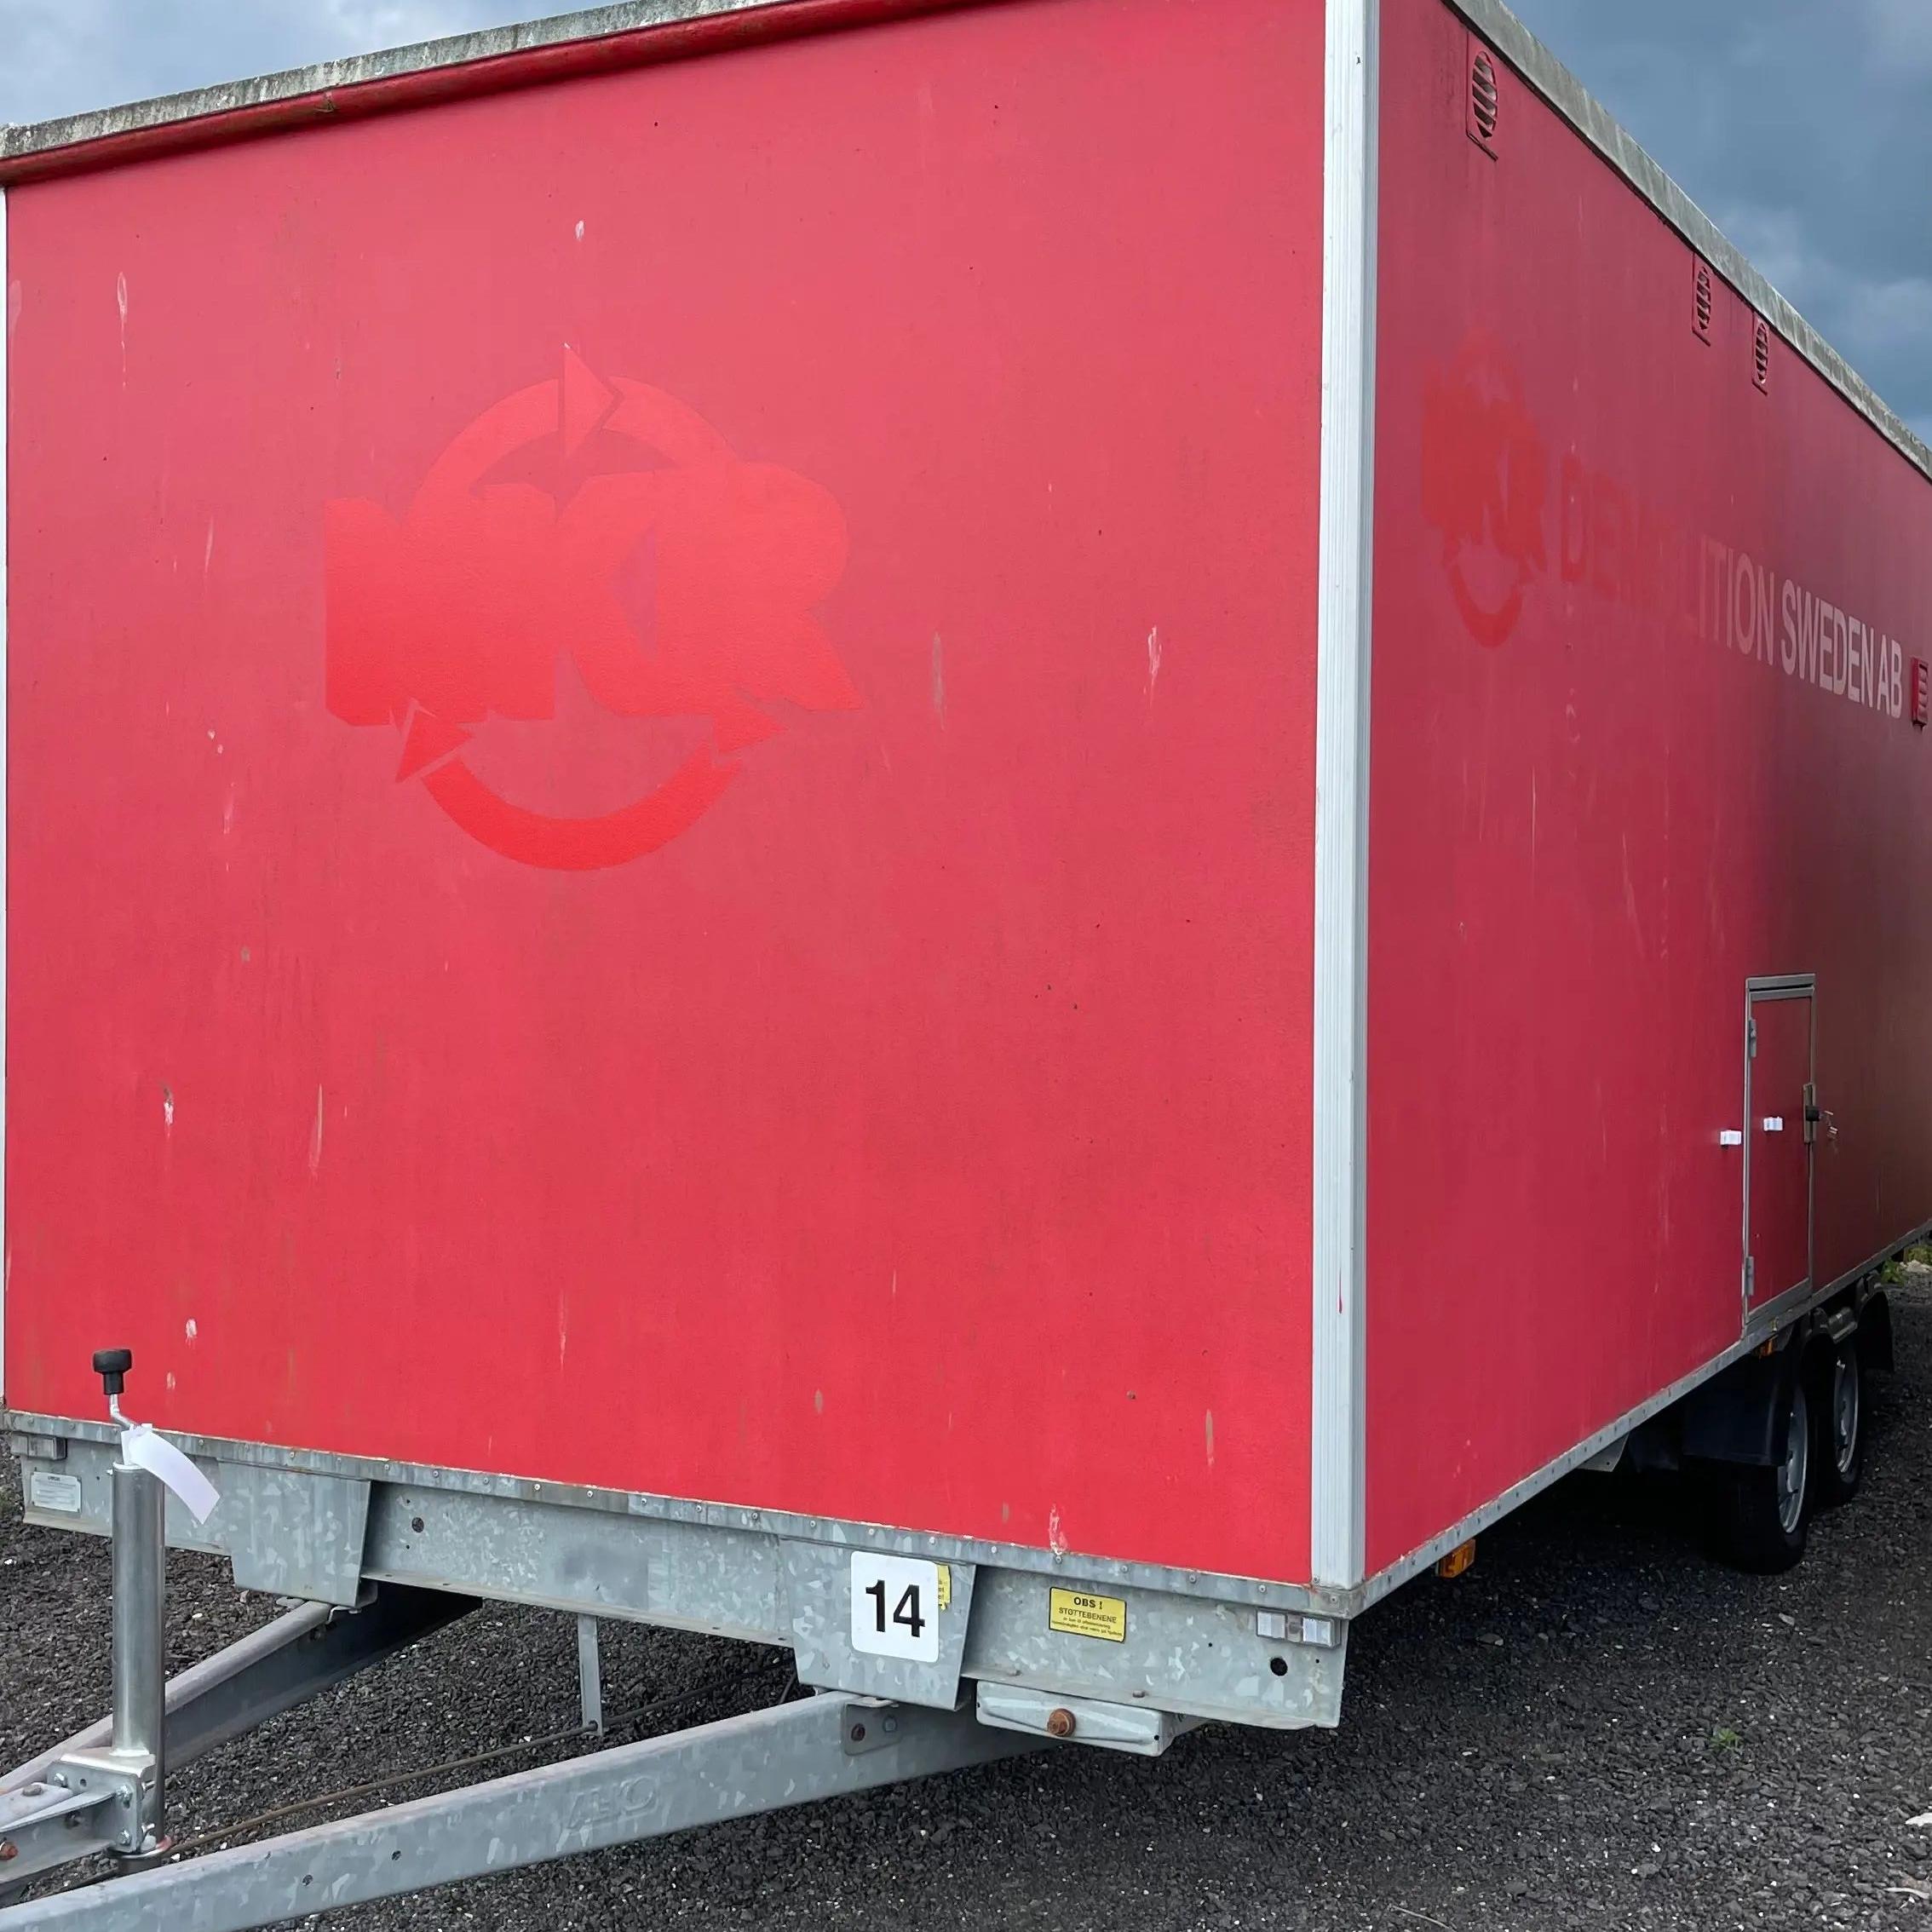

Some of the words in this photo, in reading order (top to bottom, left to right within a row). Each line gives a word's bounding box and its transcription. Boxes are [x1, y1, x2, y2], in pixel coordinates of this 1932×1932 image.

[1780, 578, 1875, 709] SWEDEN
[1875, 628, 1904, 720] AB
[865, 1578, 926, 1638] 14
[1073, 1596, 1096, 1608] OBS
